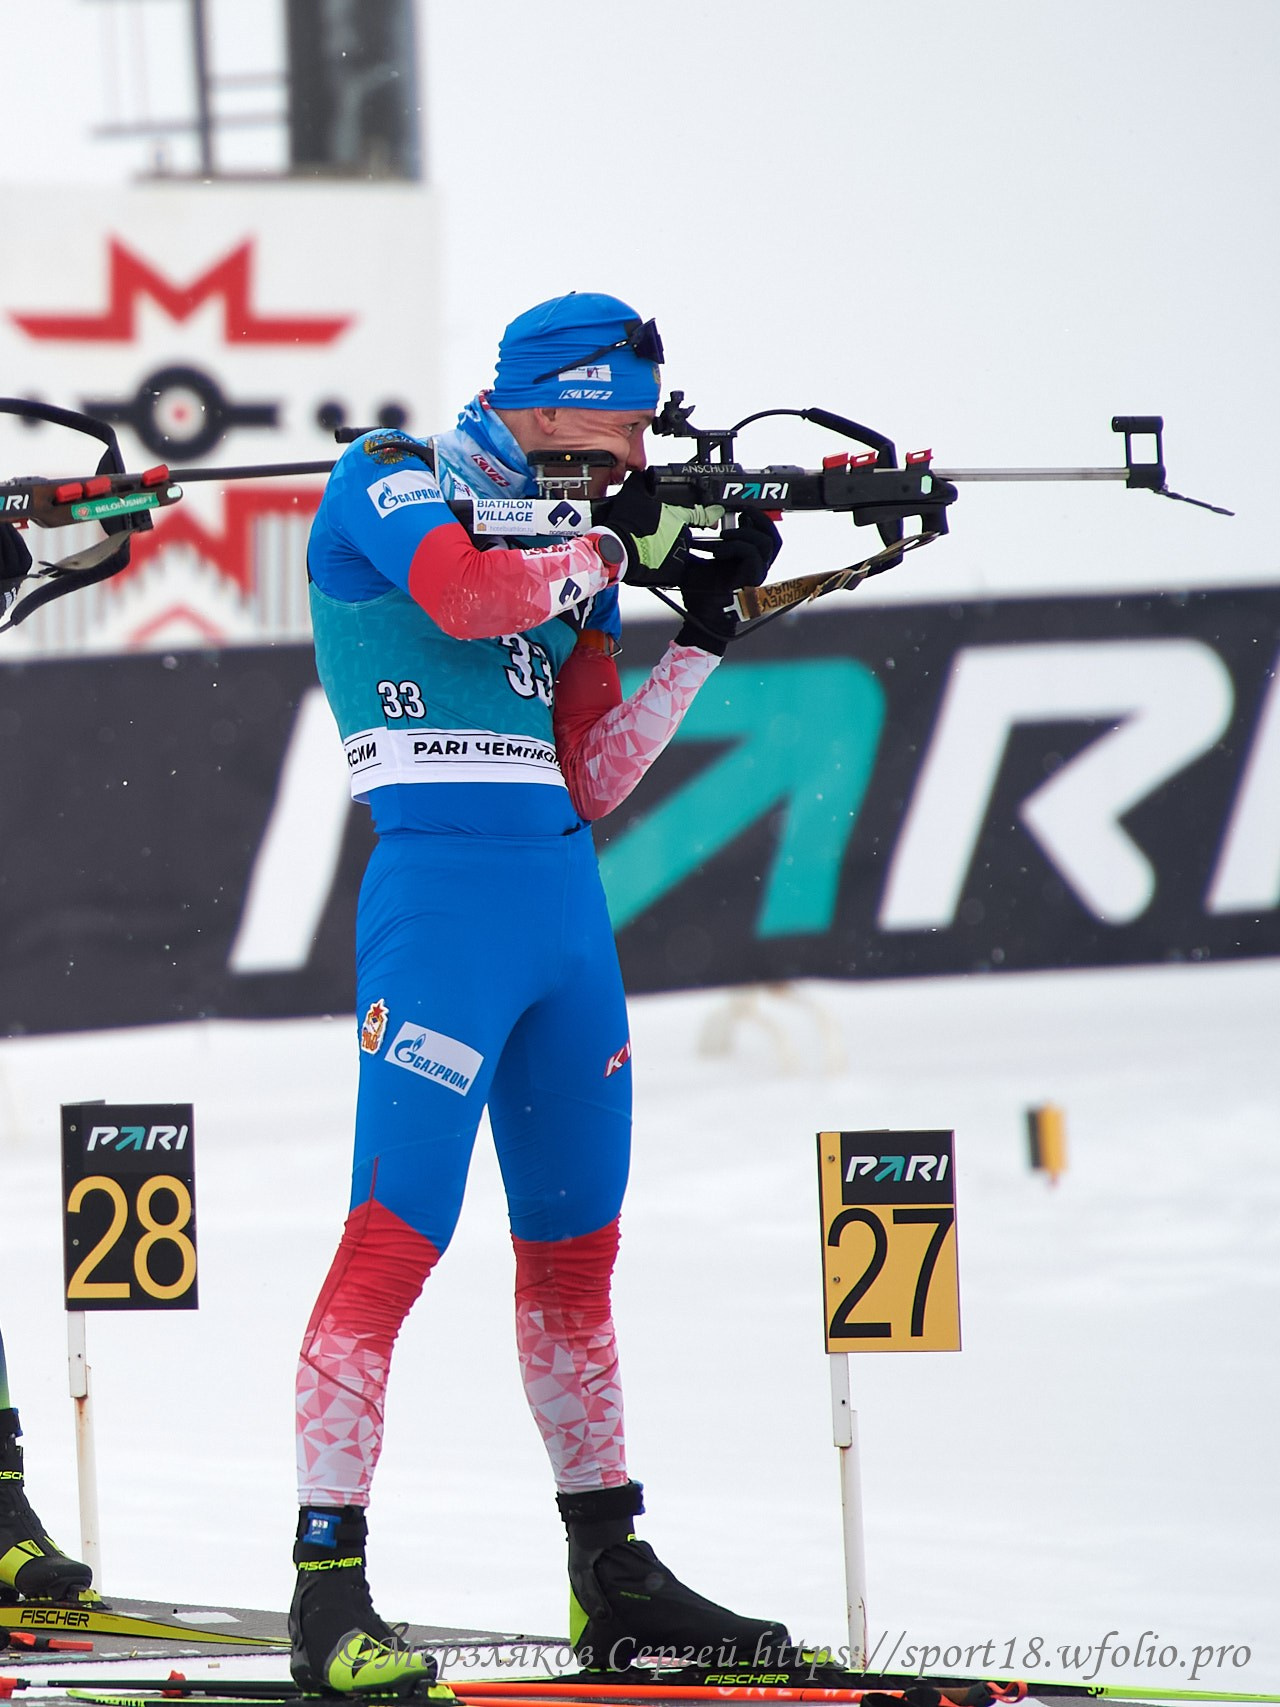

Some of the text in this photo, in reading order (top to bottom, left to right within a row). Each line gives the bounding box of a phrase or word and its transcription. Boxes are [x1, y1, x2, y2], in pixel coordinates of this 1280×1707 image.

[398, 488, 440, 503] GAZPROM
[722, 482, 789, 499] PARI
[477, 501, 533, 509] BIATHLON
[477, 510, 533, 522] VILLAGE
[377, 680, 427, 719] 33
[414, 741, 468, 755] PARI
[413, 1055, 470, 1091] GAZPROM
[87, 1124, 189, 1151] PARI
[845, 1154, 949, 1182] PARI
[67, 1174, 197, 1300] 28
[827, 1207, 955, 1338] 27
[298, 1557, 363, 1571] FISCHER
[20, 1609, 90, 1628] FISCHER
[704, 1674, 790, 1685] FISCHER
